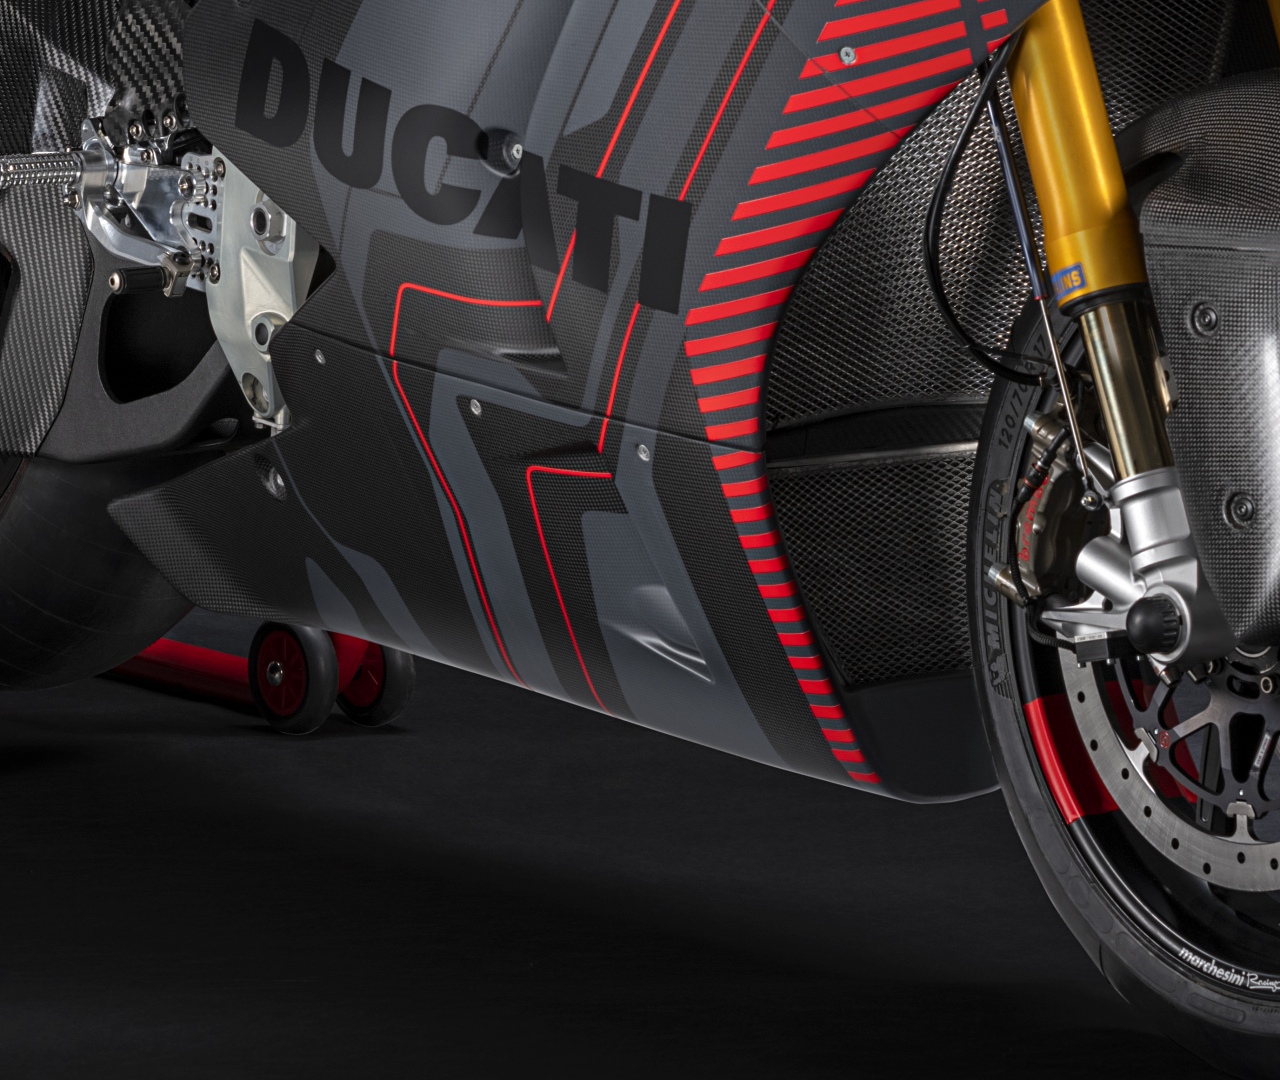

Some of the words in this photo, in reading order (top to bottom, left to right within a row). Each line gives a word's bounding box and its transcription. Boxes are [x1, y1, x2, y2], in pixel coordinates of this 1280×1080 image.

[235, 18, 693, 315] DUCATI
[1033, 333, 1047, 358] 17
[1178, 947, 1245, 986] marchesini
